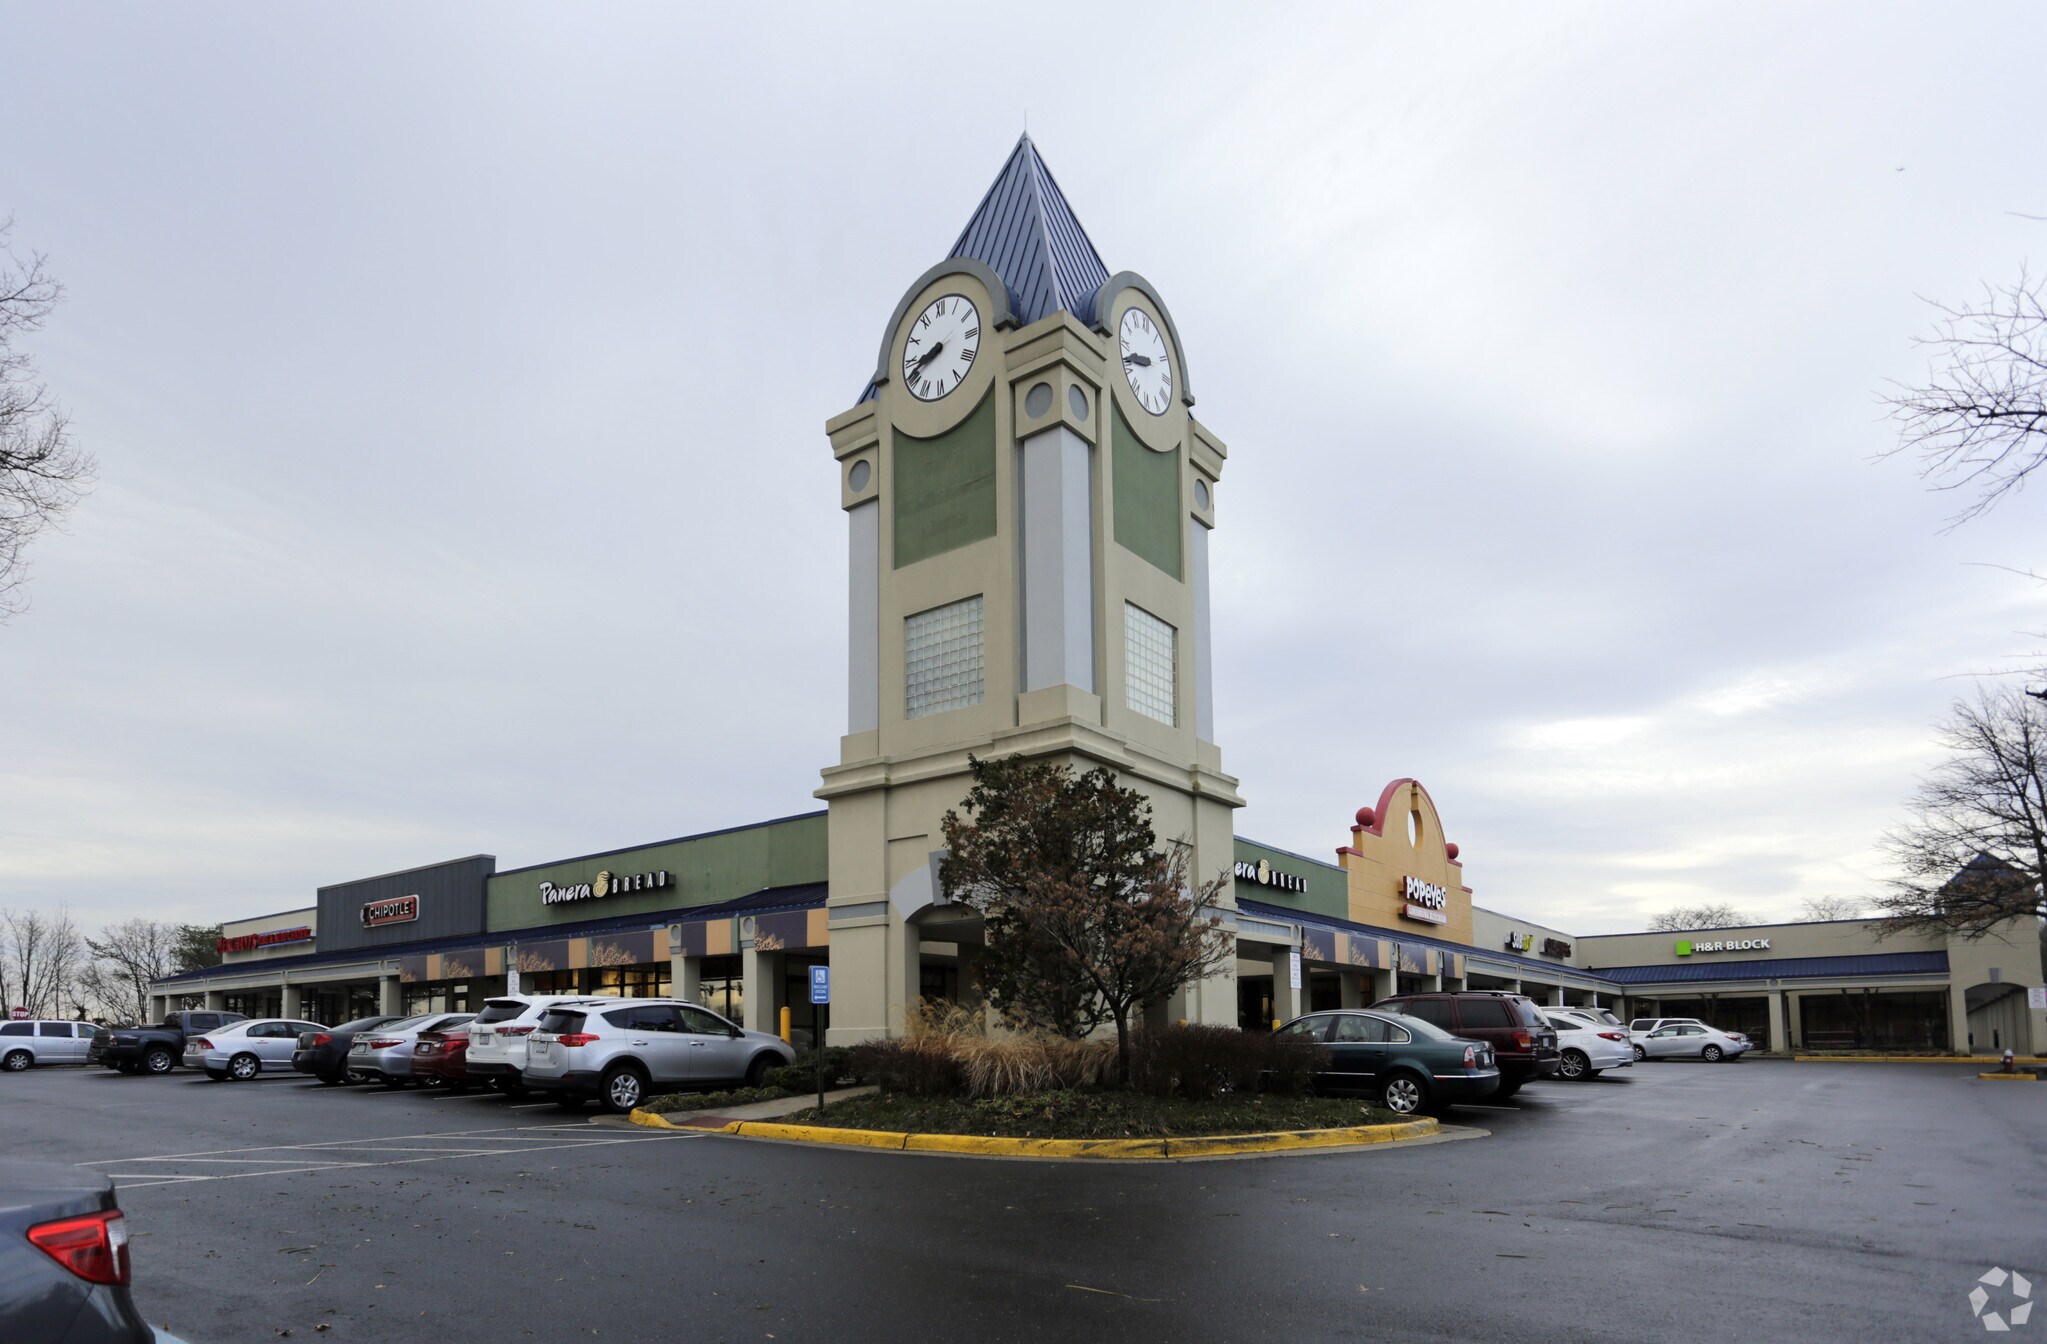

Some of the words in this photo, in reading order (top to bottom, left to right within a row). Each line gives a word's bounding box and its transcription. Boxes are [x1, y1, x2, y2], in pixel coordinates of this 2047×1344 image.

[909, 337, 921, 345] X
[540, 881, 591, 905] Panera
[612, 871, 665, 894] BREAD
[369, 901, 410, 919] CHIPOTLE
[1695, 941, 1723, 952] H&R
[1726, 939, 1770, 951] BLOCK
